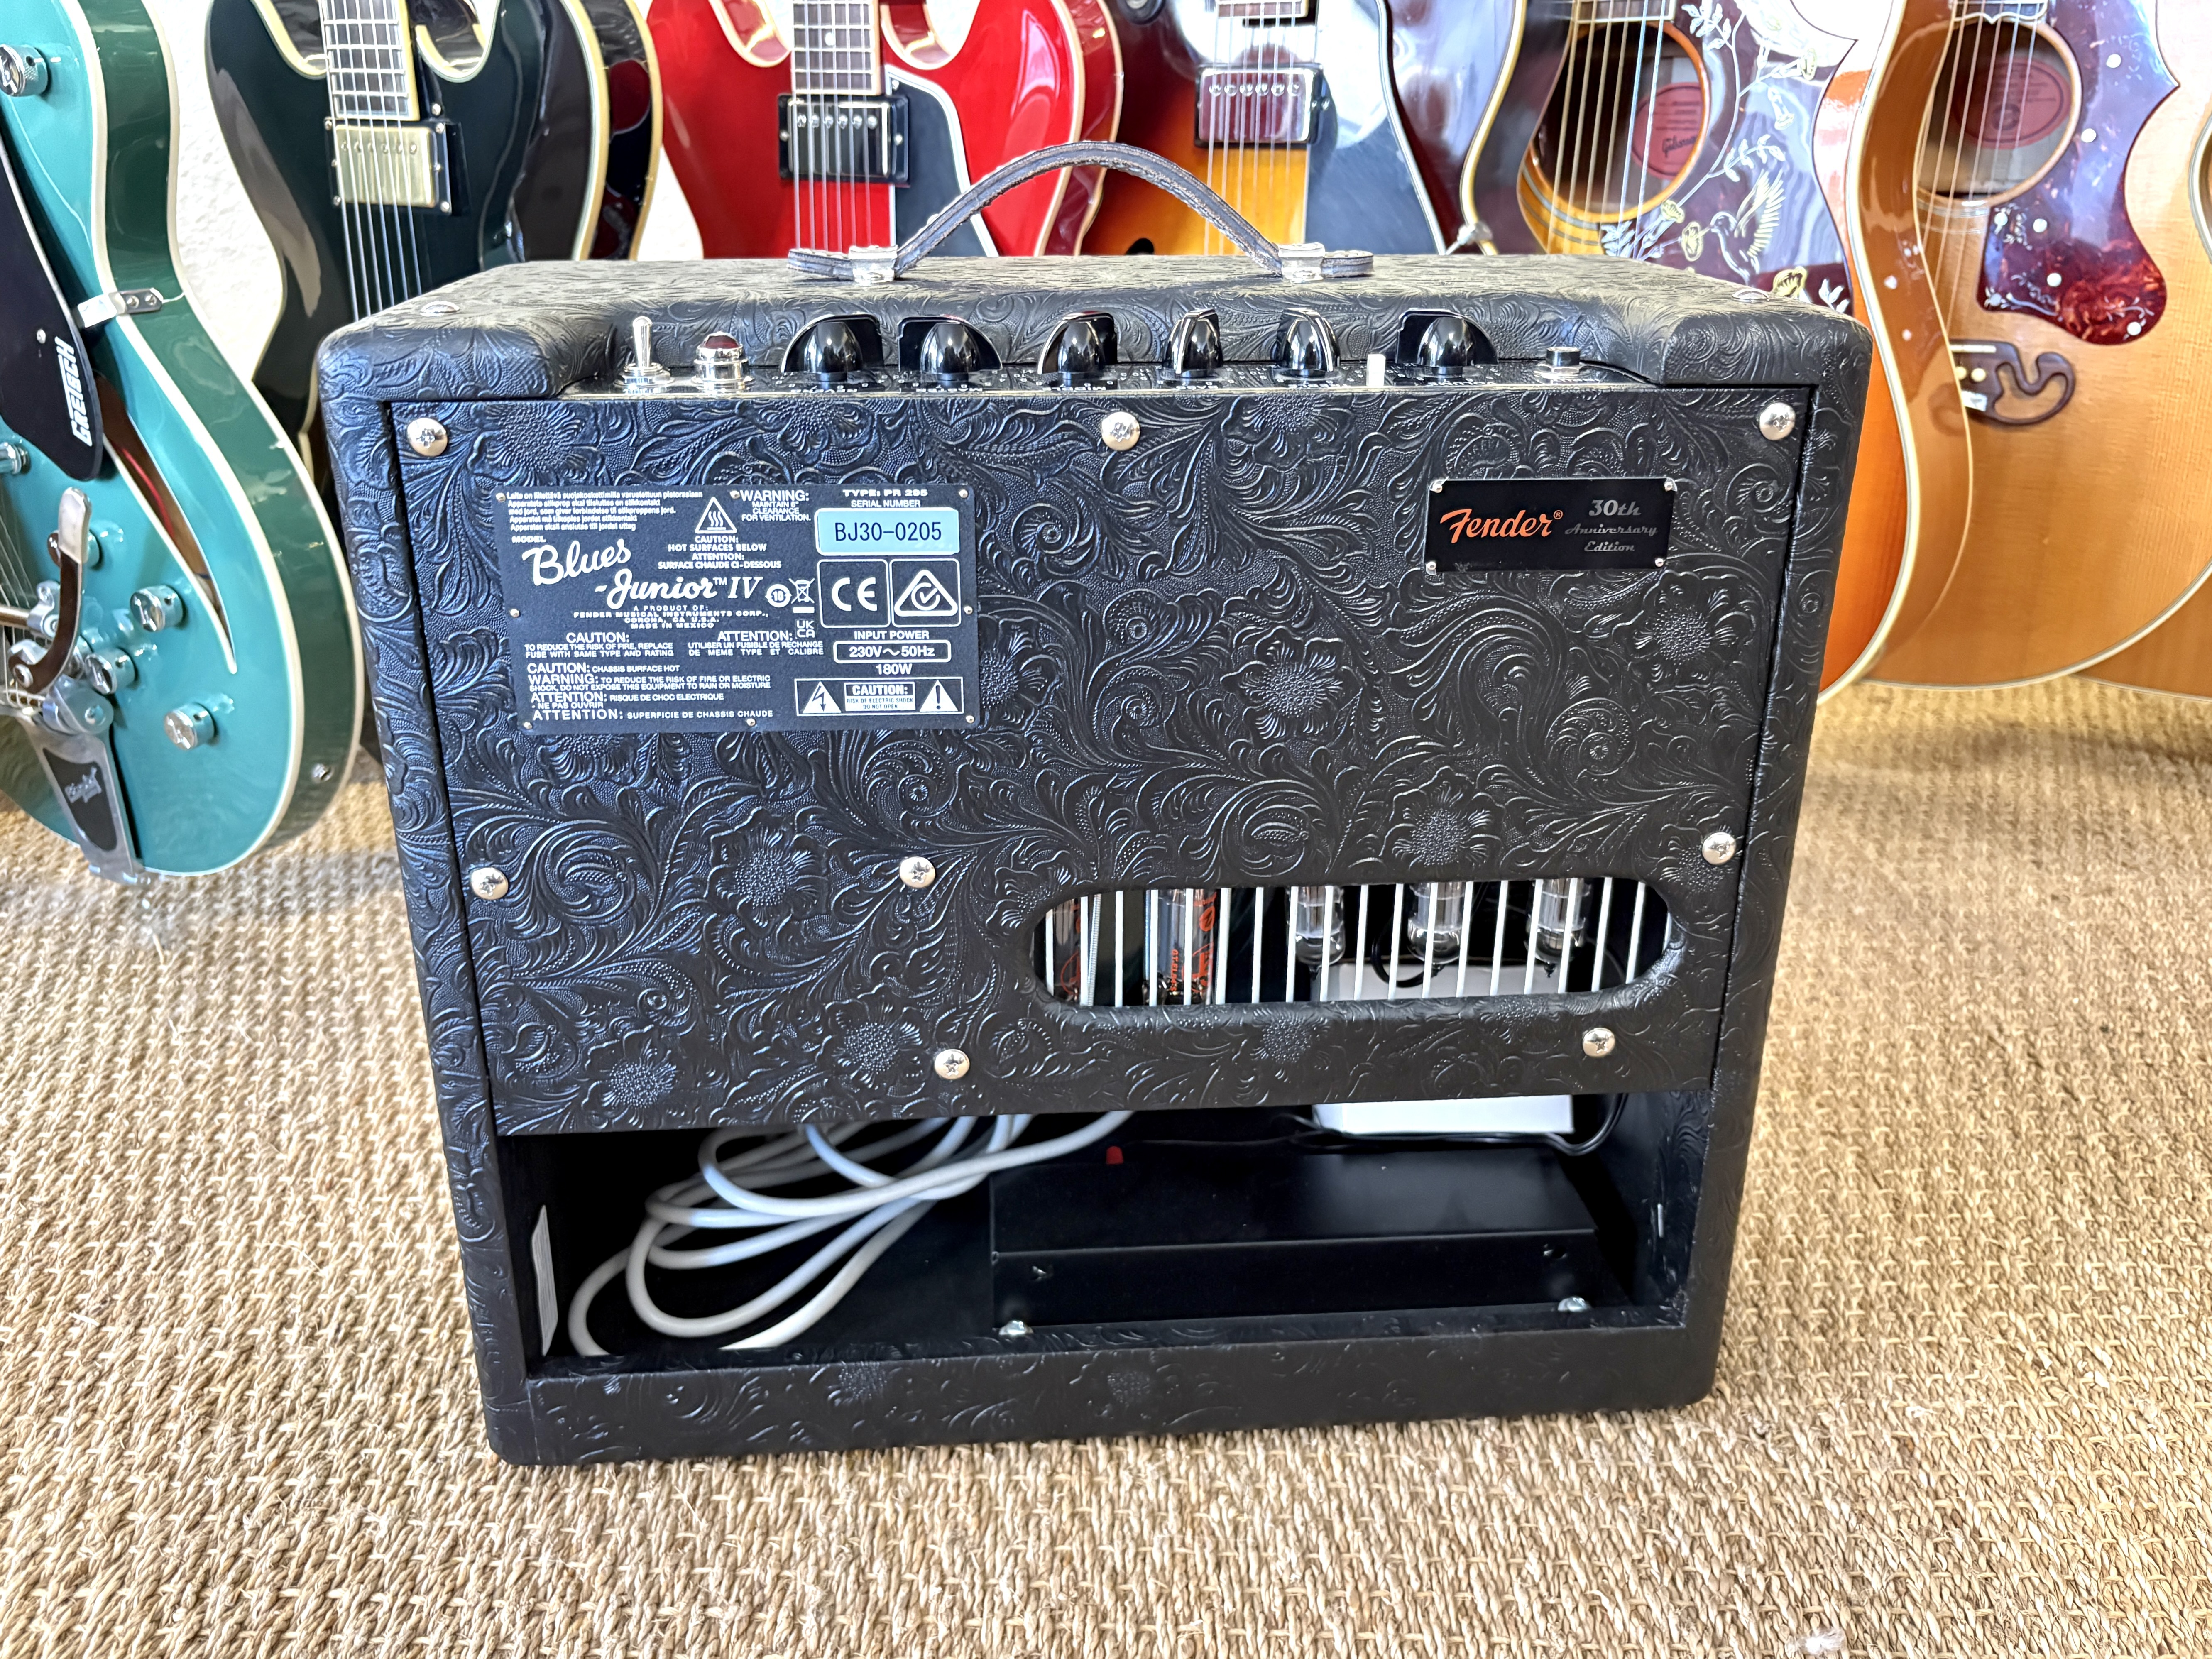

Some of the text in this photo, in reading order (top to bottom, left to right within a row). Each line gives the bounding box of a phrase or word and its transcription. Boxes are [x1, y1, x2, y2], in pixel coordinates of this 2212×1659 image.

[54, 336, 93, 447] GRETSCH
[740, 490, 809, 501] WARNING:
[1589, 500, 1641, 516] 30th
[835, 522, 942, 541] BJ30-0205
[1564, 524, 1658, 536] Anniversary
[1584, 541, 1635, 551] Edition
[522, 538, 631, 586] Blues
[728, 577, 763, 598] IV
[832, 577, 877, 611] CE
[797, 620, 814, 629] UK
[566, 632, 629, 644] CAUTION:
[718, 631, 793, 641] ATTENTION:
[798, 630, 815, 639] CA
[854, 630, 929, 640] INPUT POWER
[527, 662, 590, 673] CAUTION:
[876, 663, 912, 675] 180W
[528, 673, 598, 685] WARNING:
[852, 685, 908, 695] CAUTION:
[531, 692, 607, 702] ATTENTION:
[533, 709, 623, 720] ATTENTION:
